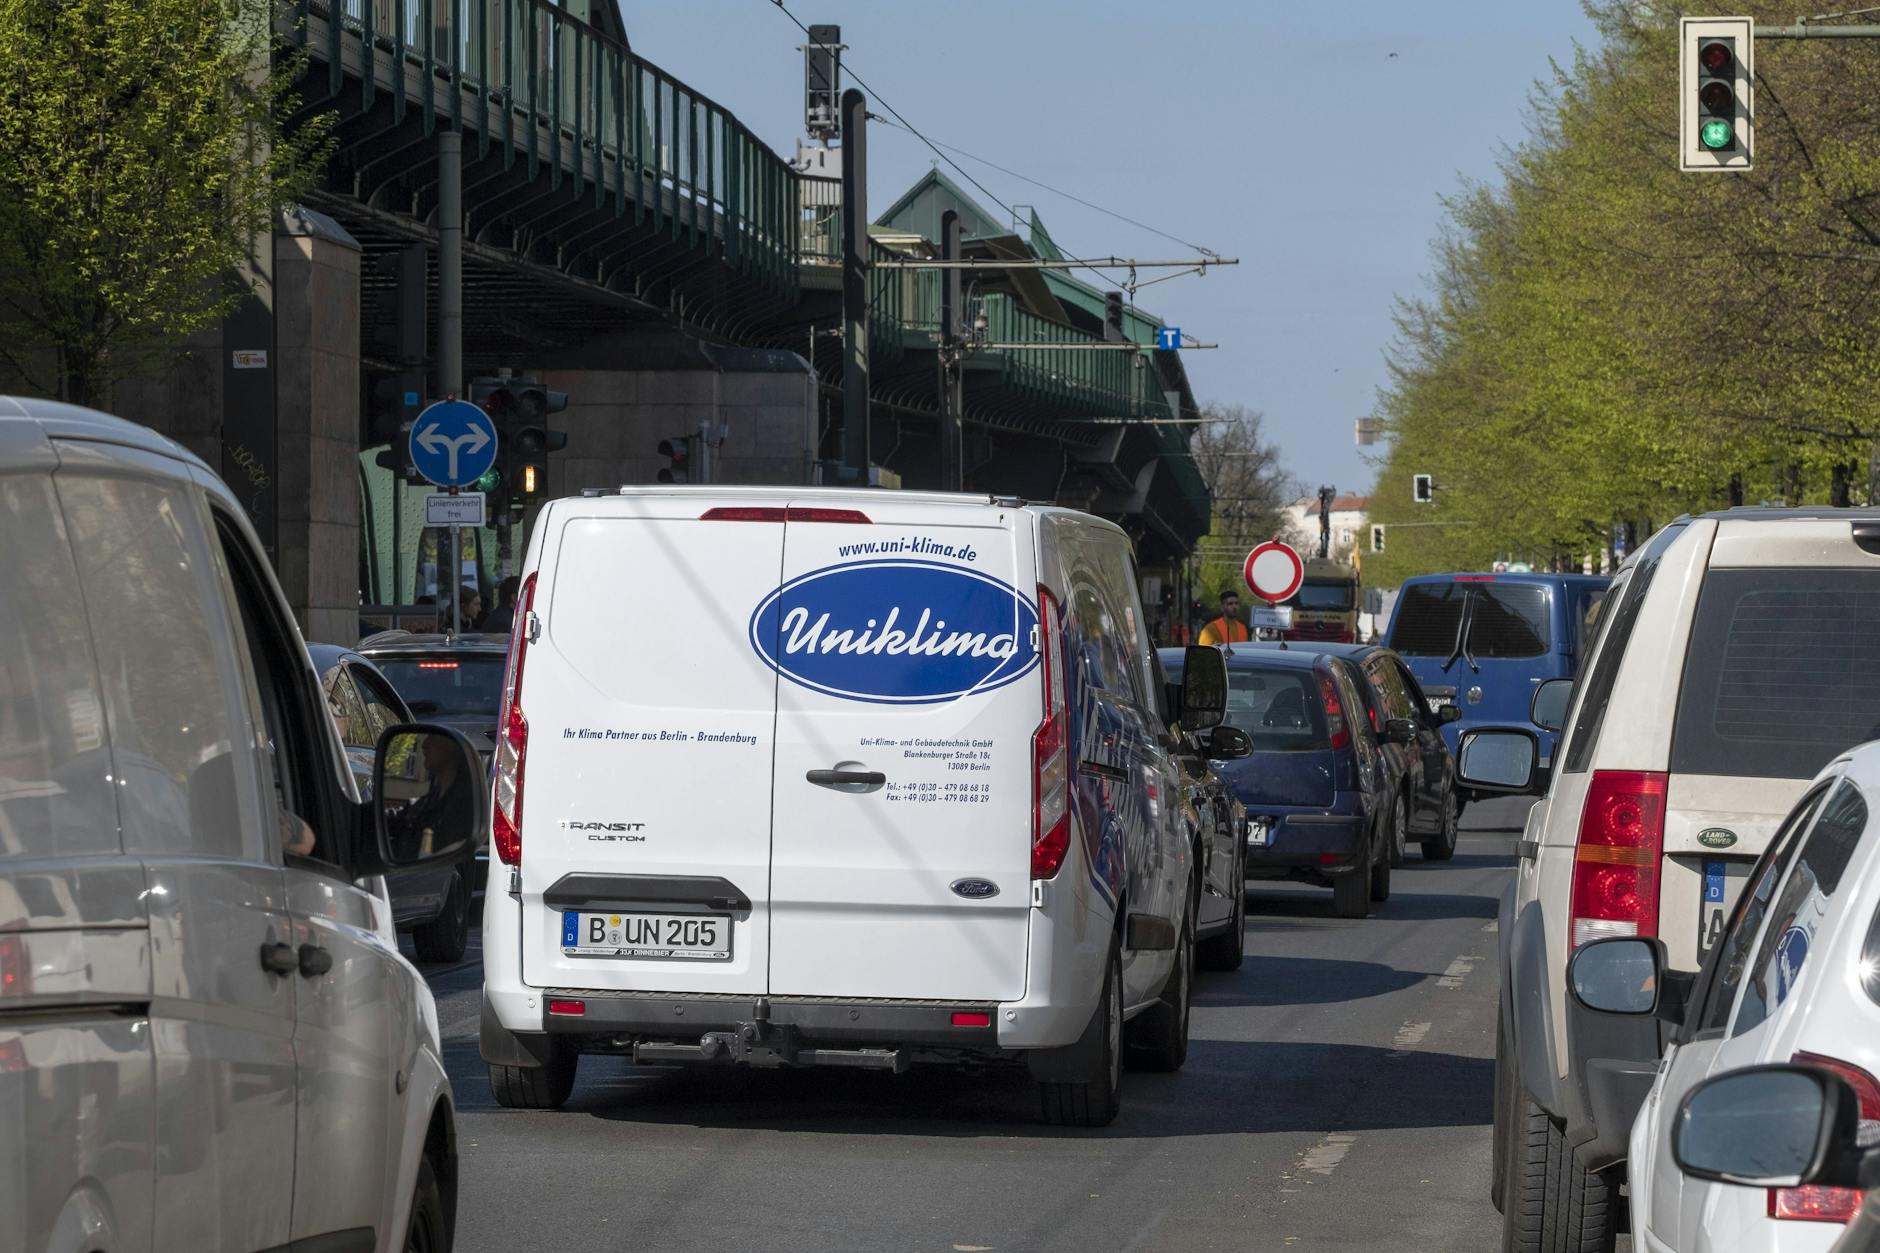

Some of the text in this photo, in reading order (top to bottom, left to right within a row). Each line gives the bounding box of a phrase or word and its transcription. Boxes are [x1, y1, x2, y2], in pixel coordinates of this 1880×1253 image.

[447, 510, 462, 518] frei
[839, 536, 977, 562] www.uni-klima.de
[781, 606, 1018, 659] Uniklima
[563, 728, 576, 739] Ihr
[578, 728, 603, 739] Klima
[605, 729, 640, 740] Partner
[641, 732, 657, 741] aus
[660, 730, 688, 741] Berlin
[697, 731, 758, 746] Brandenburg
[860, 738, 994, 748] Uni-Klima- und Gebäudetechnik GmbH
[903, 750, 991, 761] Blankenburger Straße 18c
[947, 762, 991, 771] 13089 Berlin
[903, 783, 917, 791] +49
[918, 782, 937, 793] (0)30
[944, 783, 958, 792] 479
[959, 784, 968, 792] 08
[969, 784, 979, 792] 68
[981, 784, 990, 793] 18
[886, 793, 901, 801] Fax:
[903, 793, 917, 802] +49
[918, 793, 937, 803] (0)30
[944, 794, 958, 802] 479
[959, 794, 968, 803] 08
[969, 794, 979, 803] 68
[980, 794, 990, 803] 29
[561, 821, 645, 831] RANSIT
[1708, 837, 1731, 845] ROVER
[1711, 887, 1719, 898] D
[589, 917, 716, 946] B UN 205
[1706, 909, 1726, 945] A
[567, 933, 574, 942] D
